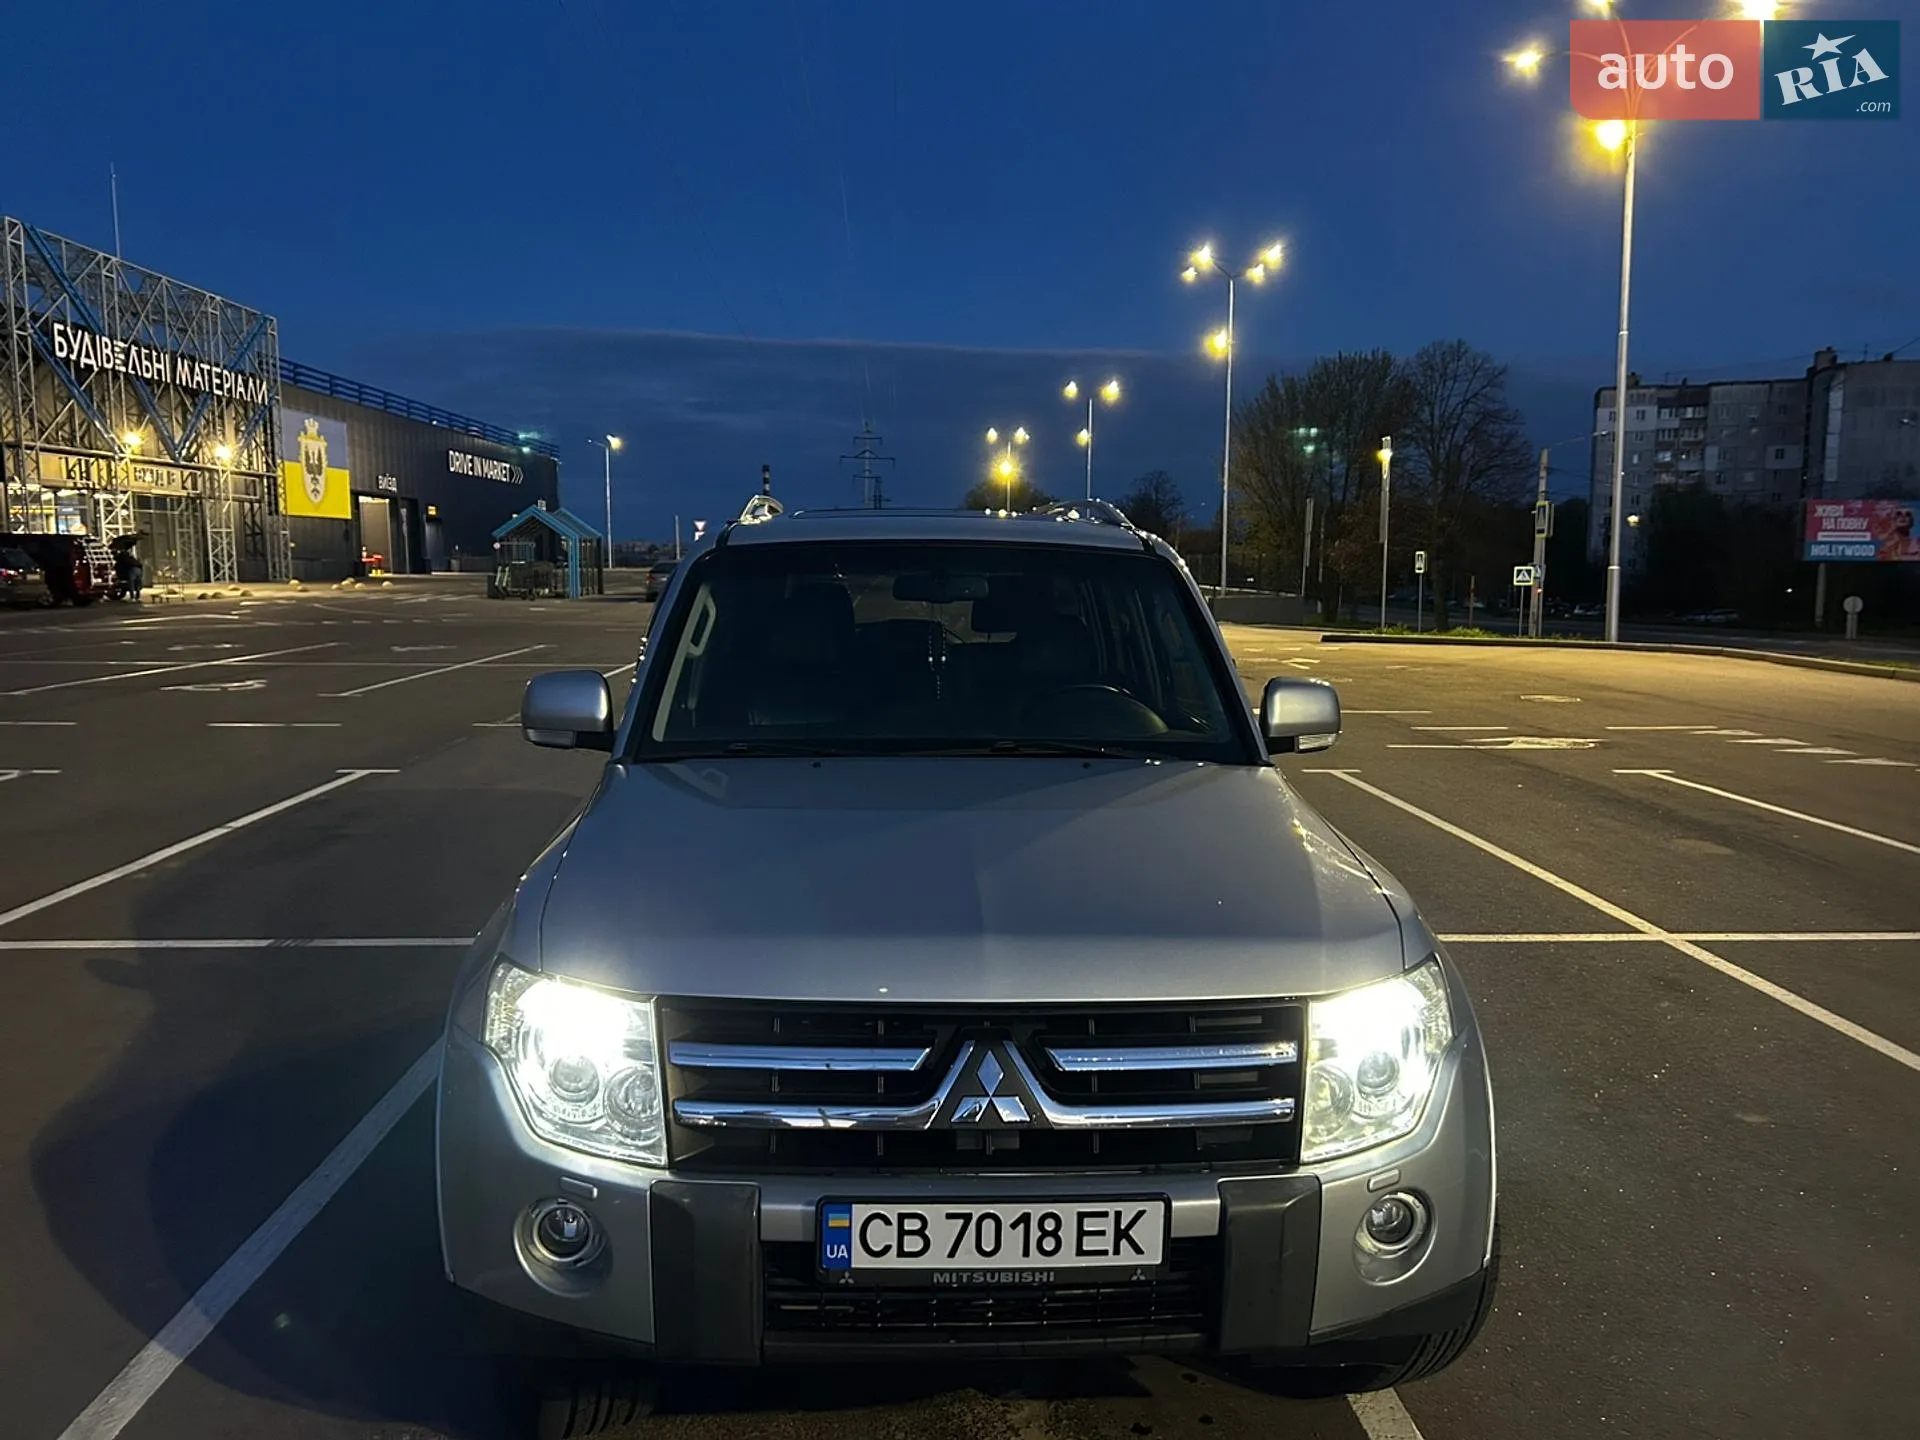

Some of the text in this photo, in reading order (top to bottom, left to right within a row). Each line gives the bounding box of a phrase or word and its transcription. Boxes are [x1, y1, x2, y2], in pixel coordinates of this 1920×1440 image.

[53, 322, 268, 406] БУДІВЕЛЬНІ МАТЕРІАЛИ
[448, 450, 510, 483] DRIVE IN MARKET
[1810, 544, 1875, 557] HOLLYWOOD
[858, 1209, 1147, 1259] CB 7018 EK
[826, 1244, 848, 1259] UA
[933, 1271, 1055, 1284] MITSUBISHI
